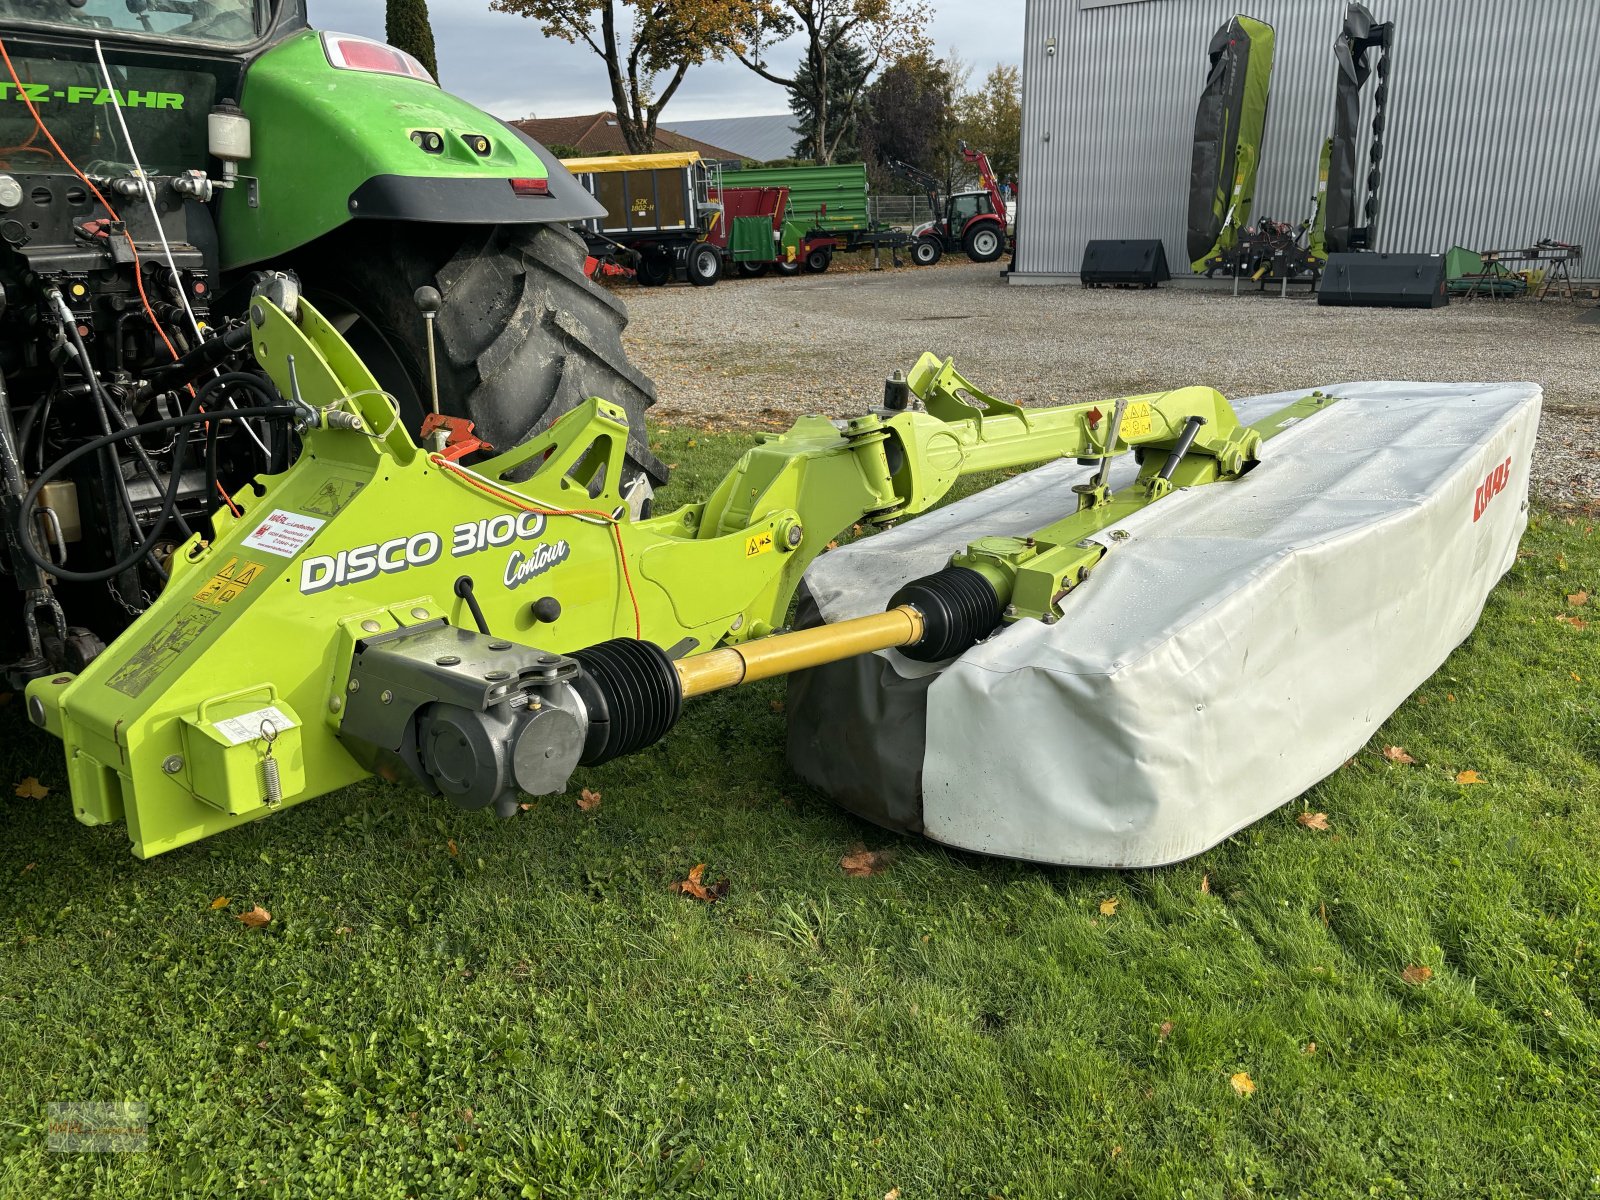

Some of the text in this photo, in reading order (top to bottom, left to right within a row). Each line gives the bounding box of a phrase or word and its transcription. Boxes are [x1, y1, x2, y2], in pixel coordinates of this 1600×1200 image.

[300, 508, 547, 596] DISCO 3100
[503, 538, 570, 591] Contour
